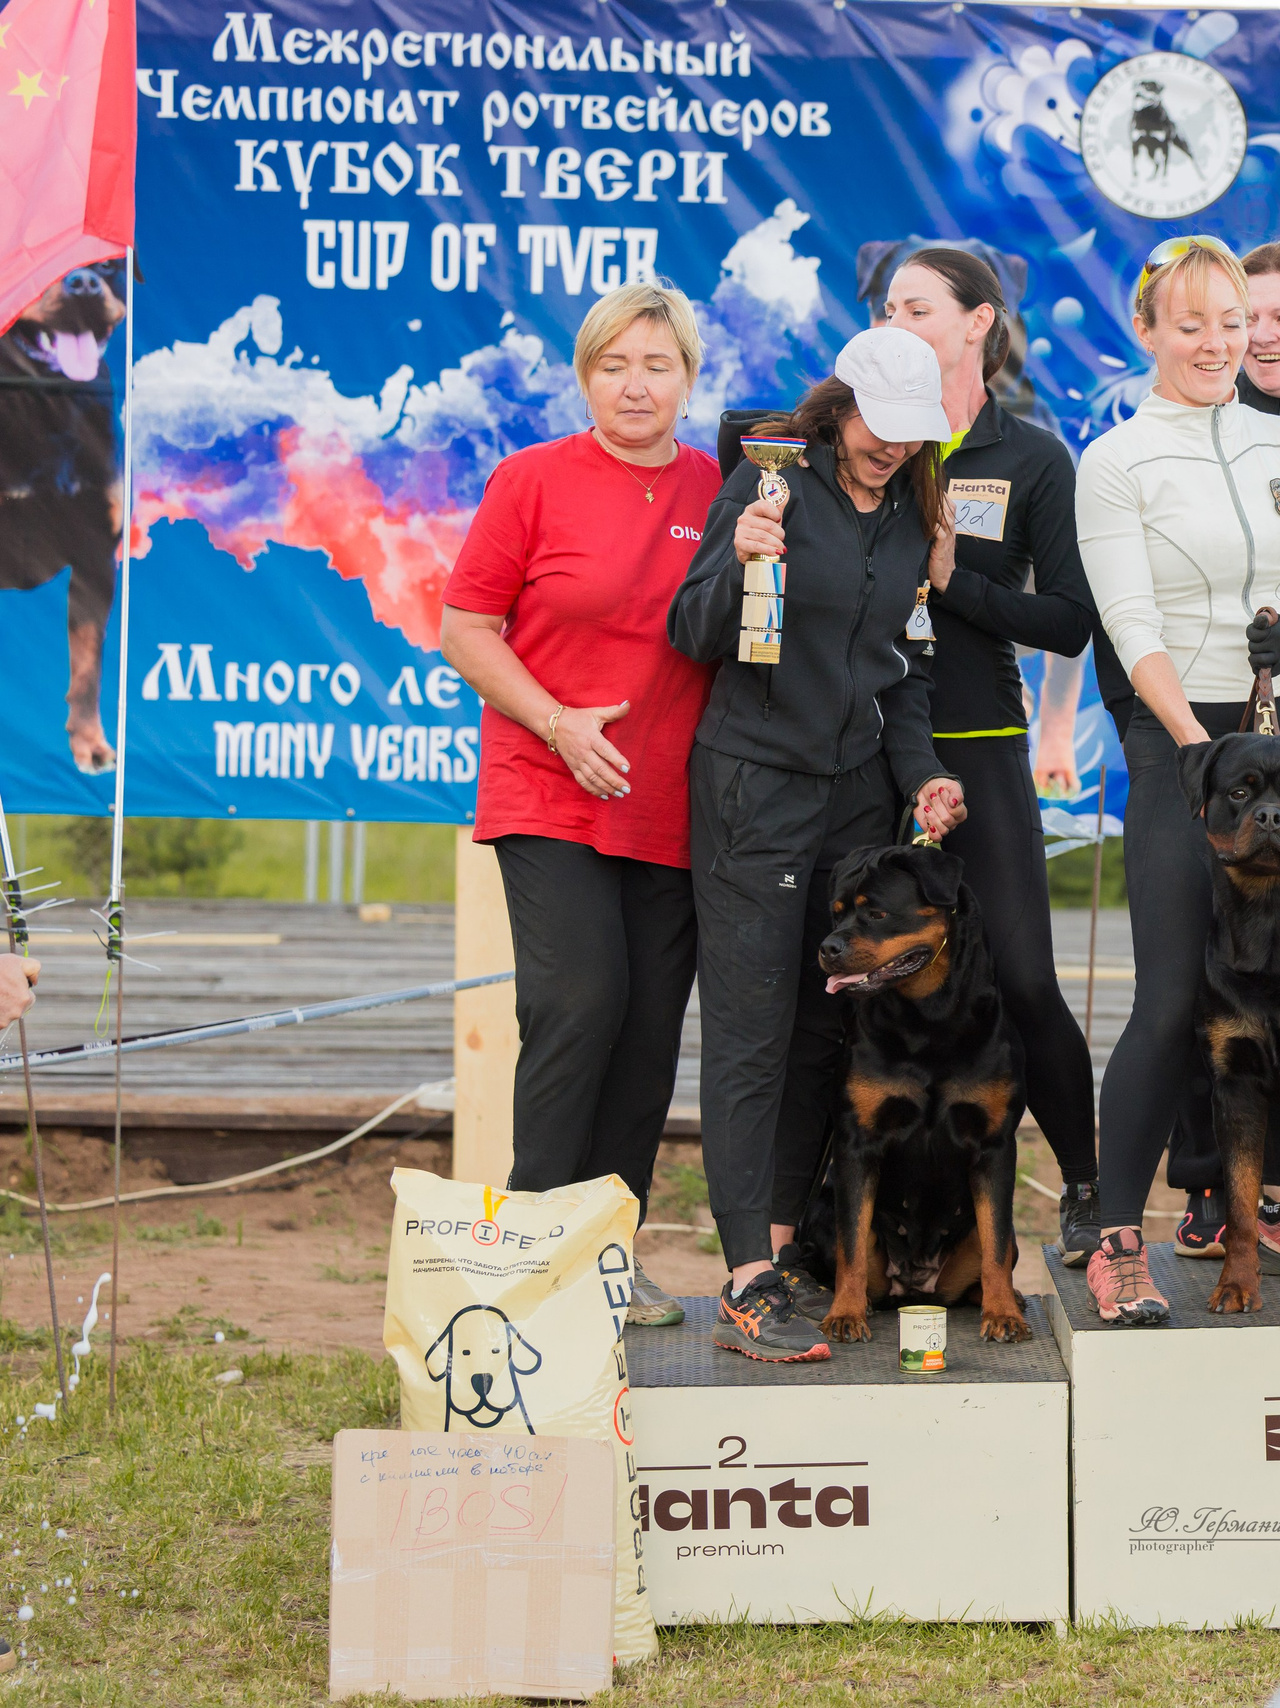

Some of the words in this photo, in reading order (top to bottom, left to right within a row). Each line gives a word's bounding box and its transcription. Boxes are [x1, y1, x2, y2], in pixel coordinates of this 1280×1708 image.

[212, 11, 752, 80] Межрегиональный
[136, 68, 460, 127] Чемпионат
[482, 87, 832, 150] ротвейлеров
[234, 139, 463, 209] КУБОК
[489, 145, 729, 205] ТВЕРИ
[303, 219, 410, 291] CUP
[431, 222, 497, 293] OF
[952, 483, 1006, 495] Hanta
[669, 525, 704, 541] Olb
[142, 643, 361, 707] Много
[388, 666, 484, 709] ле
[214, 721, 335, 780] MANY
[350, 723, 479, 784] YEARS
[405, 1218, 564, 1250] PROFIFED
[412, 1266, 455, 1274] НАЧИНАЕТСЯ
[461, 1267, 515, 1278] ПРАВИЛЬНОГО
[473, 1260, 503, 1271] ЗАБОТА
[508, 1260, 551, 1270] ПИТОМЦАХ
[718, 1435, 748, 1468] 2
[638, 1477, 870, 1532] anta
[677, 1539, 785, 1561] premium
